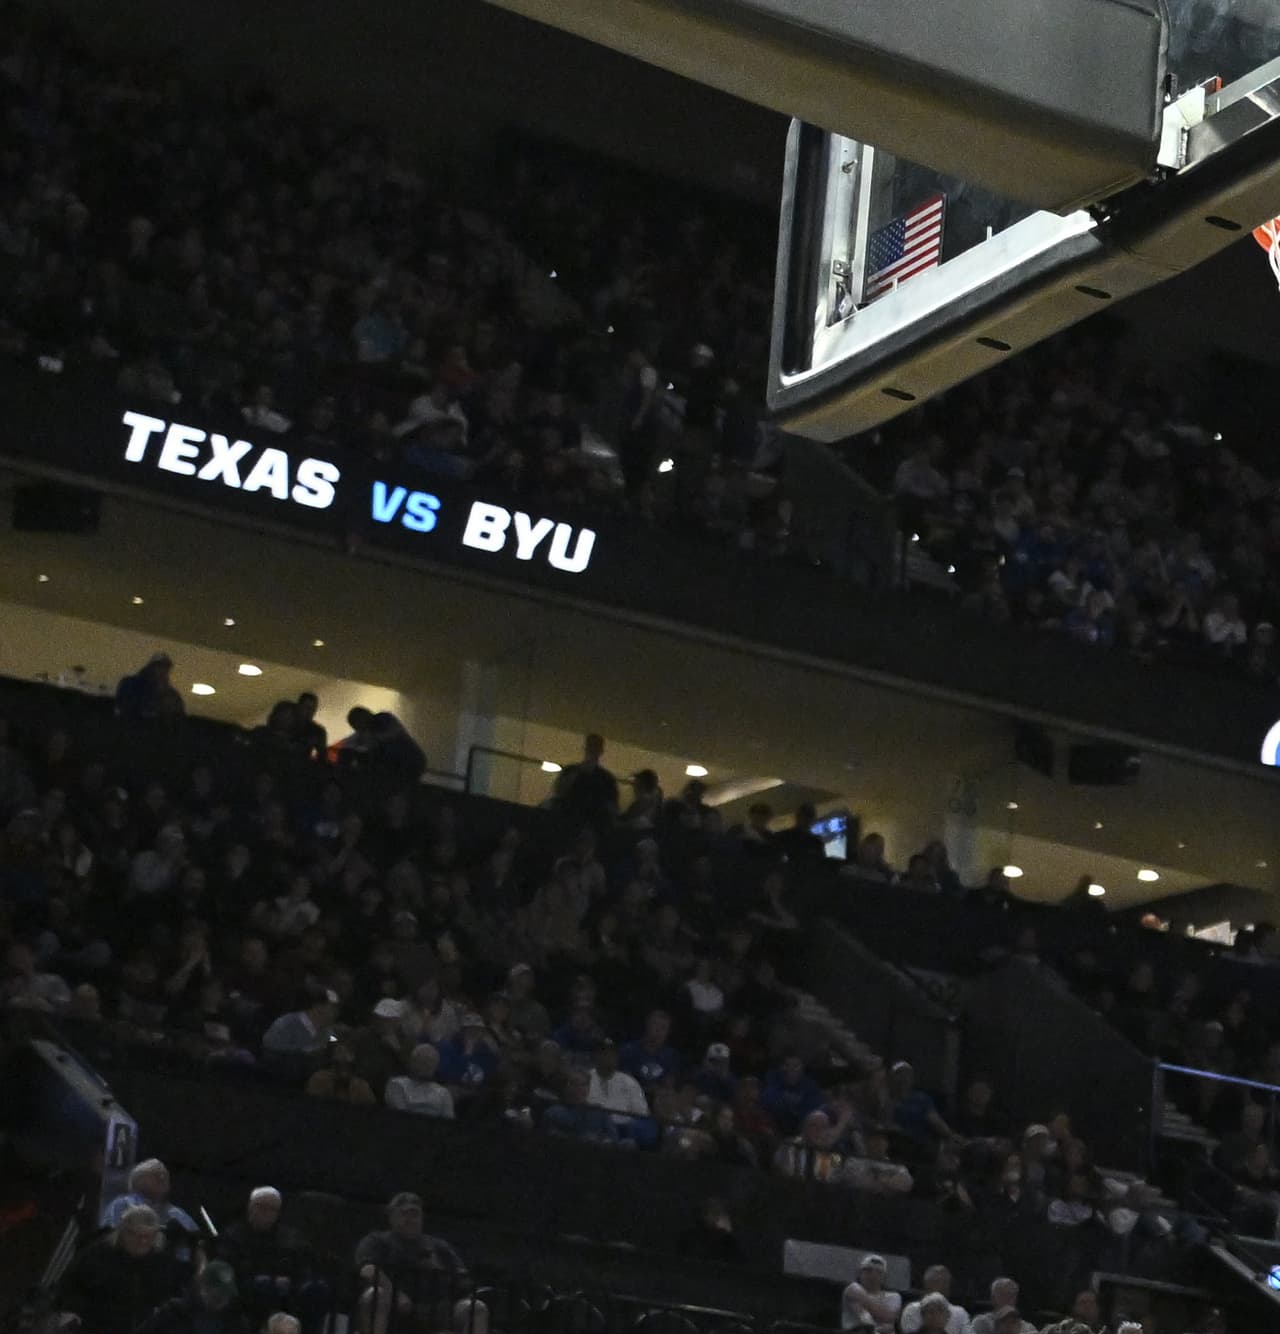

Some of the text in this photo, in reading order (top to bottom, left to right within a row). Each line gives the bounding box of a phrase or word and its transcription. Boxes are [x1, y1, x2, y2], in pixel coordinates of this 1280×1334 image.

[122, 411, 598, 575] TEXAS VS BYU
